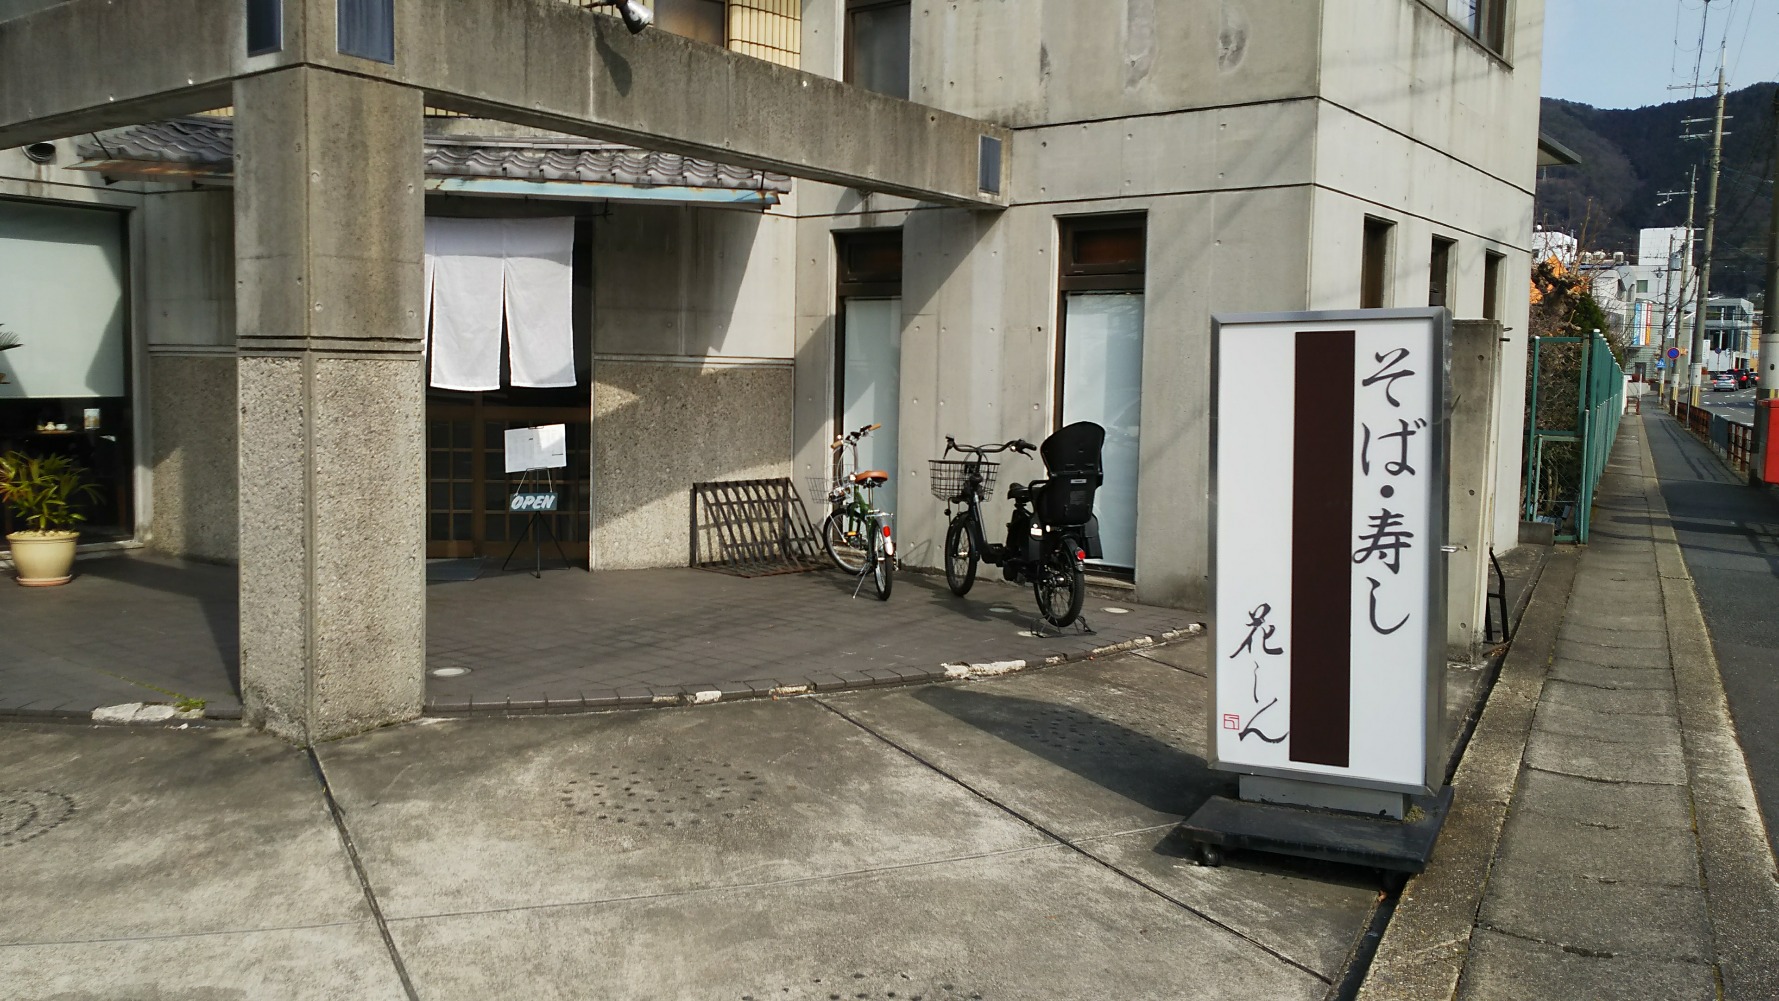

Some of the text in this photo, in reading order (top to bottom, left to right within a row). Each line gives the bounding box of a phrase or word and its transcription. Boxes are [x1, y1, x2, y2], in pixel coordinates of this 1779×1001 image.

[511, 495, 555, 510] OPEN
[1352, 347, 1427, 635] そば・寿し
[1229, 603, 1289, 743] 花しん
